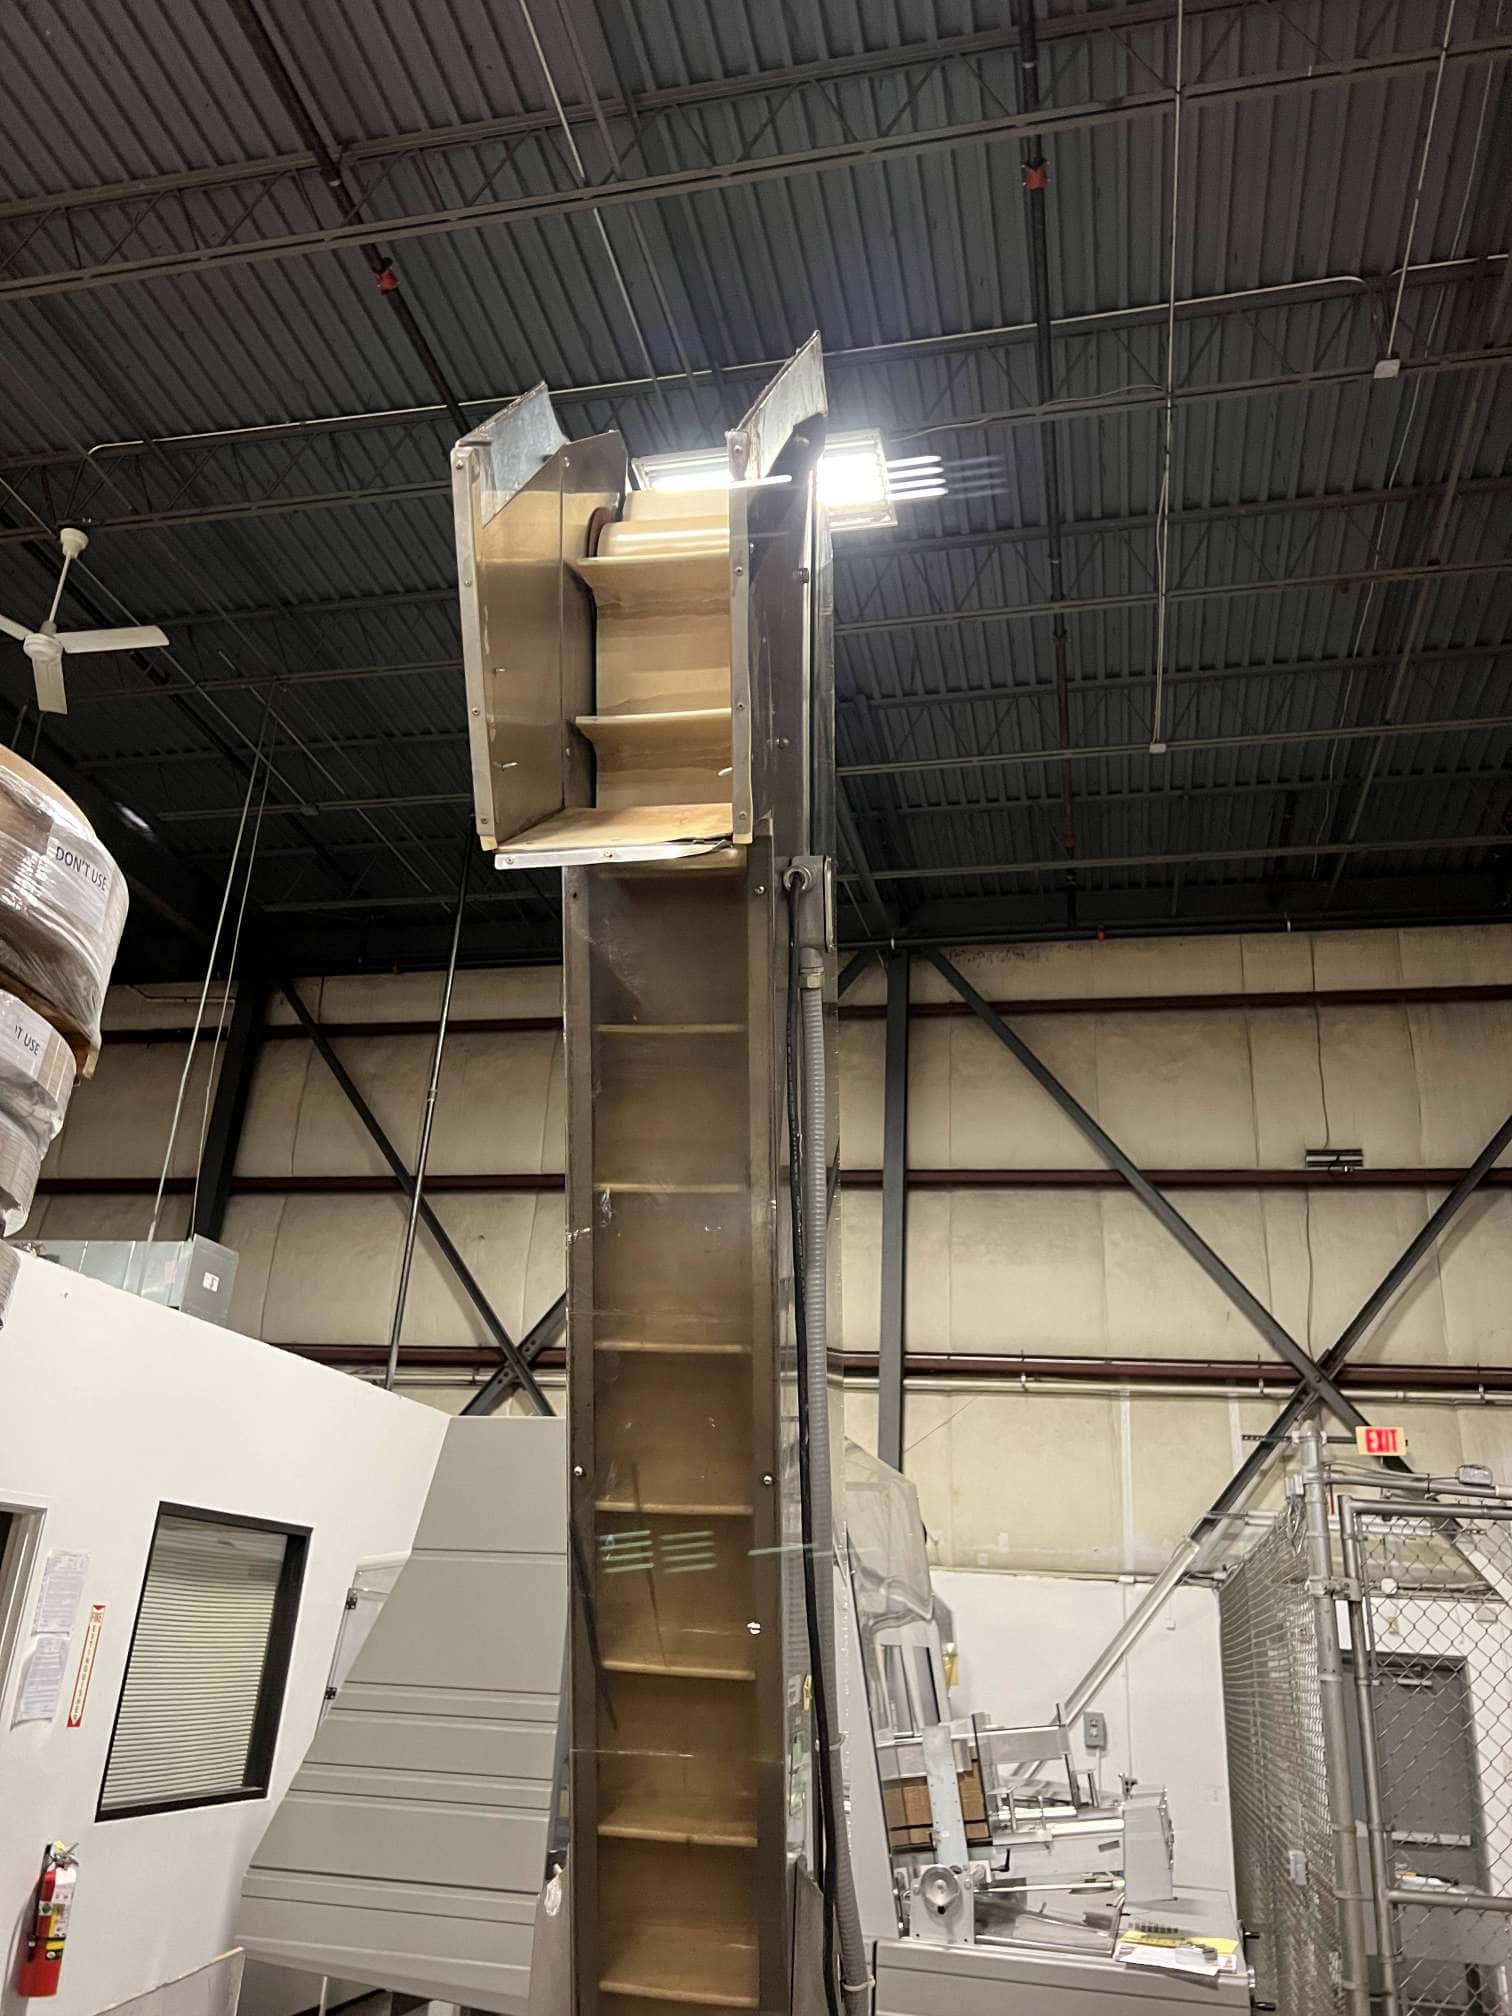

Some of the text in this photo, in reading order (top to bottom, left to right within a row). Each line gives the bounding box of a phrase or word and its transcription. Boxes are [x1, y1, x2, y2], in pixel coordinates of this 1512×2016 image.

[56, 846, 107, 891] DON'T USE
[24, 1033, 40, 1056] USE
[1365, 1428, 1398, 1453] EXIT
